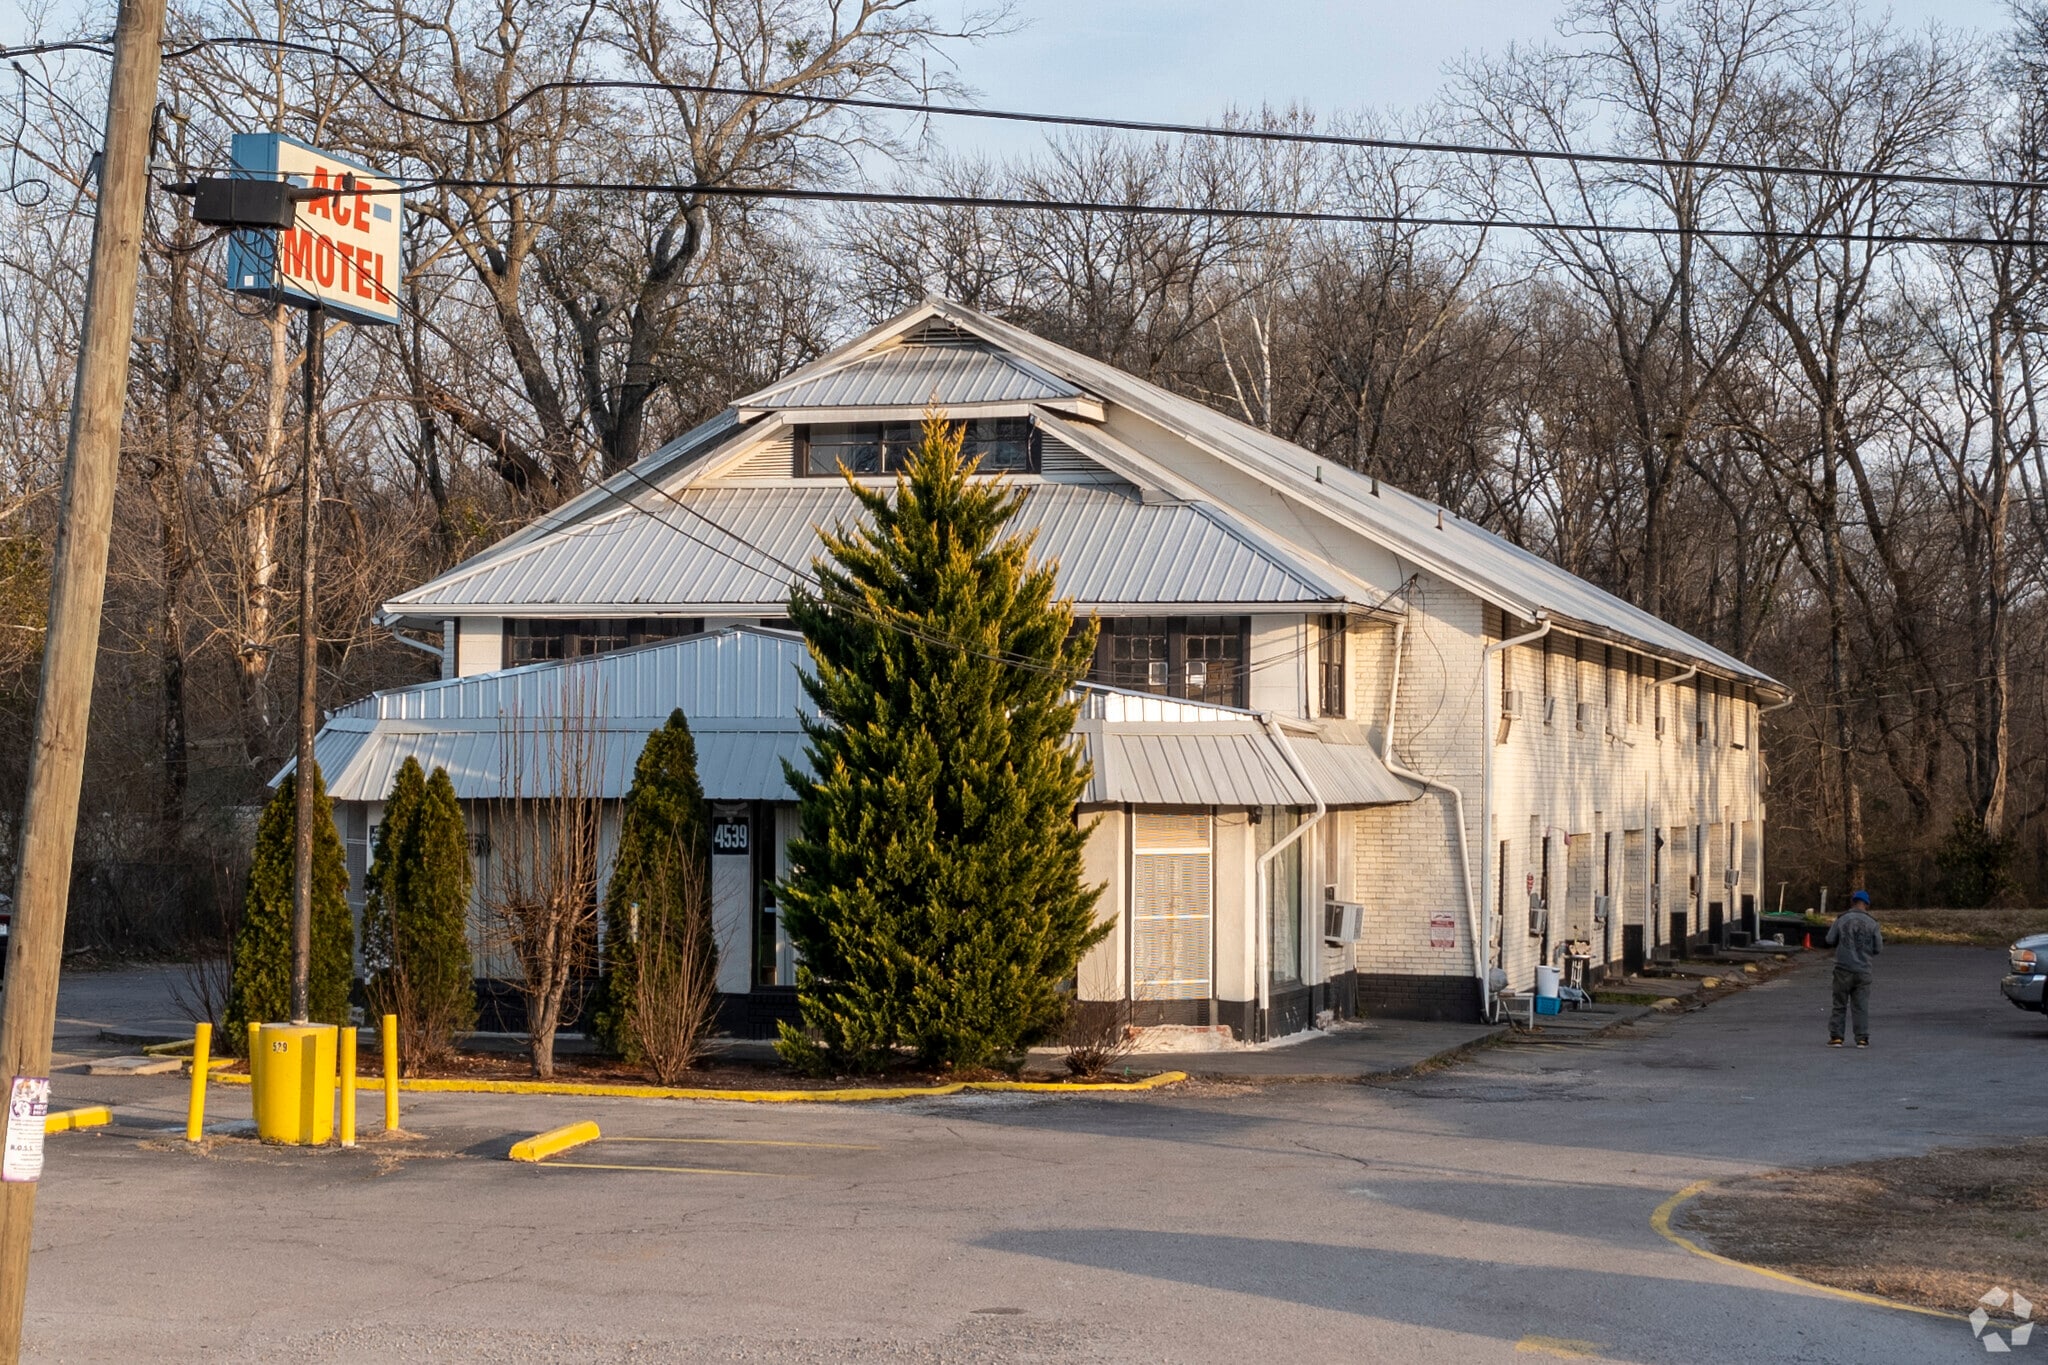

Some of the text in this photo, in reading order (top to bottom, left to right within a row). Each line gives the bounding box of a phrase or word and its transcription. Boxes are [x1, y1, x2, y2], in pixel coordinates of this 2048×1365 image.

[308, 165, 372, 234] ACE
[283, 226, 390, 305] MOTEL
[714, 824, 748, 848] 4539
